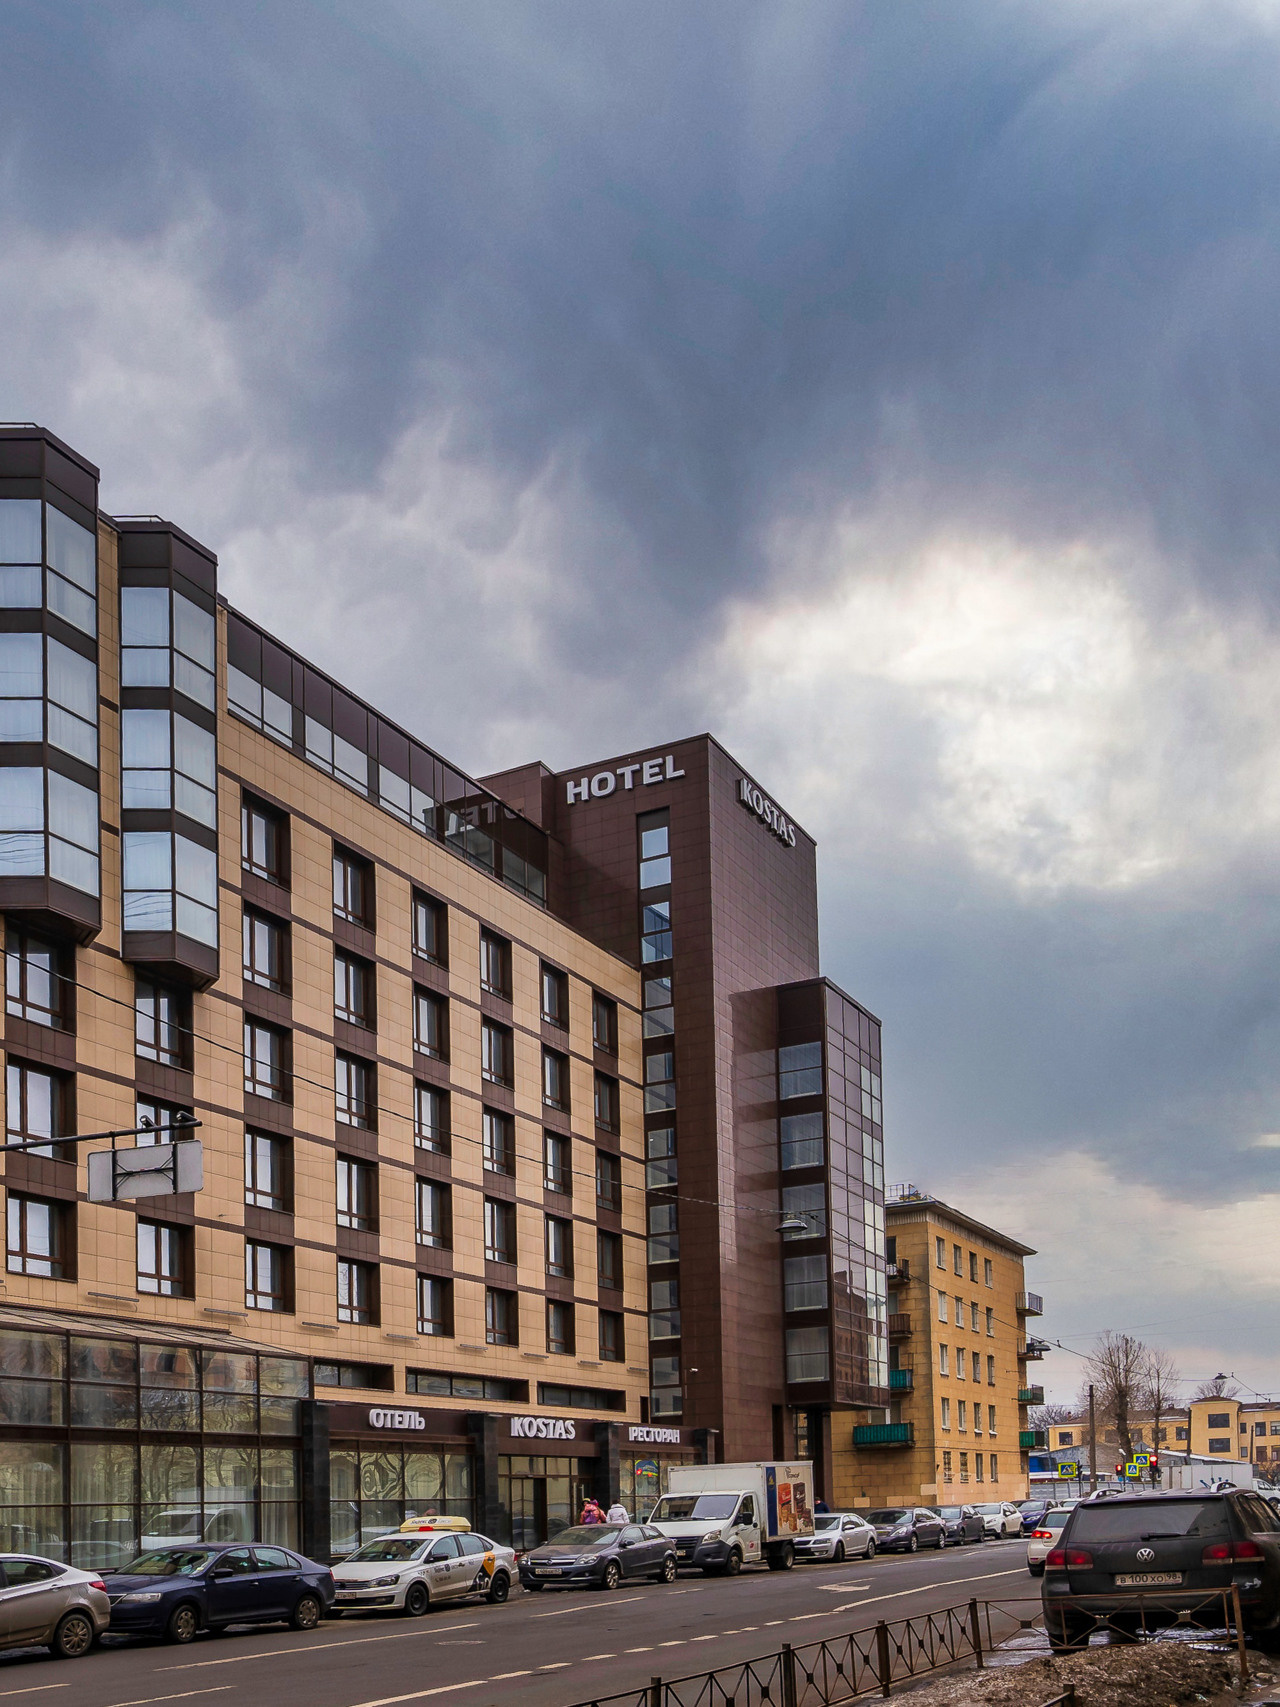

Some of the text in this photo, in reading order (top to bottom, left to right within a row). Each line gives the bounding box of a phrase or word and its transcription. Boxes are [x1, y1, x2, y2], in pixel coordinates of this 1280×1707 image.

[567, 755, 685, 804] HOTEL
[739, 777, 797, 848] KOSTAS
[369, 1408, 426, 1430] ОТЕЛЬ
[511, 1416, 576, 1439] KOSTAS
[628, 1426, 680, 1443] РЕСТОРАН
